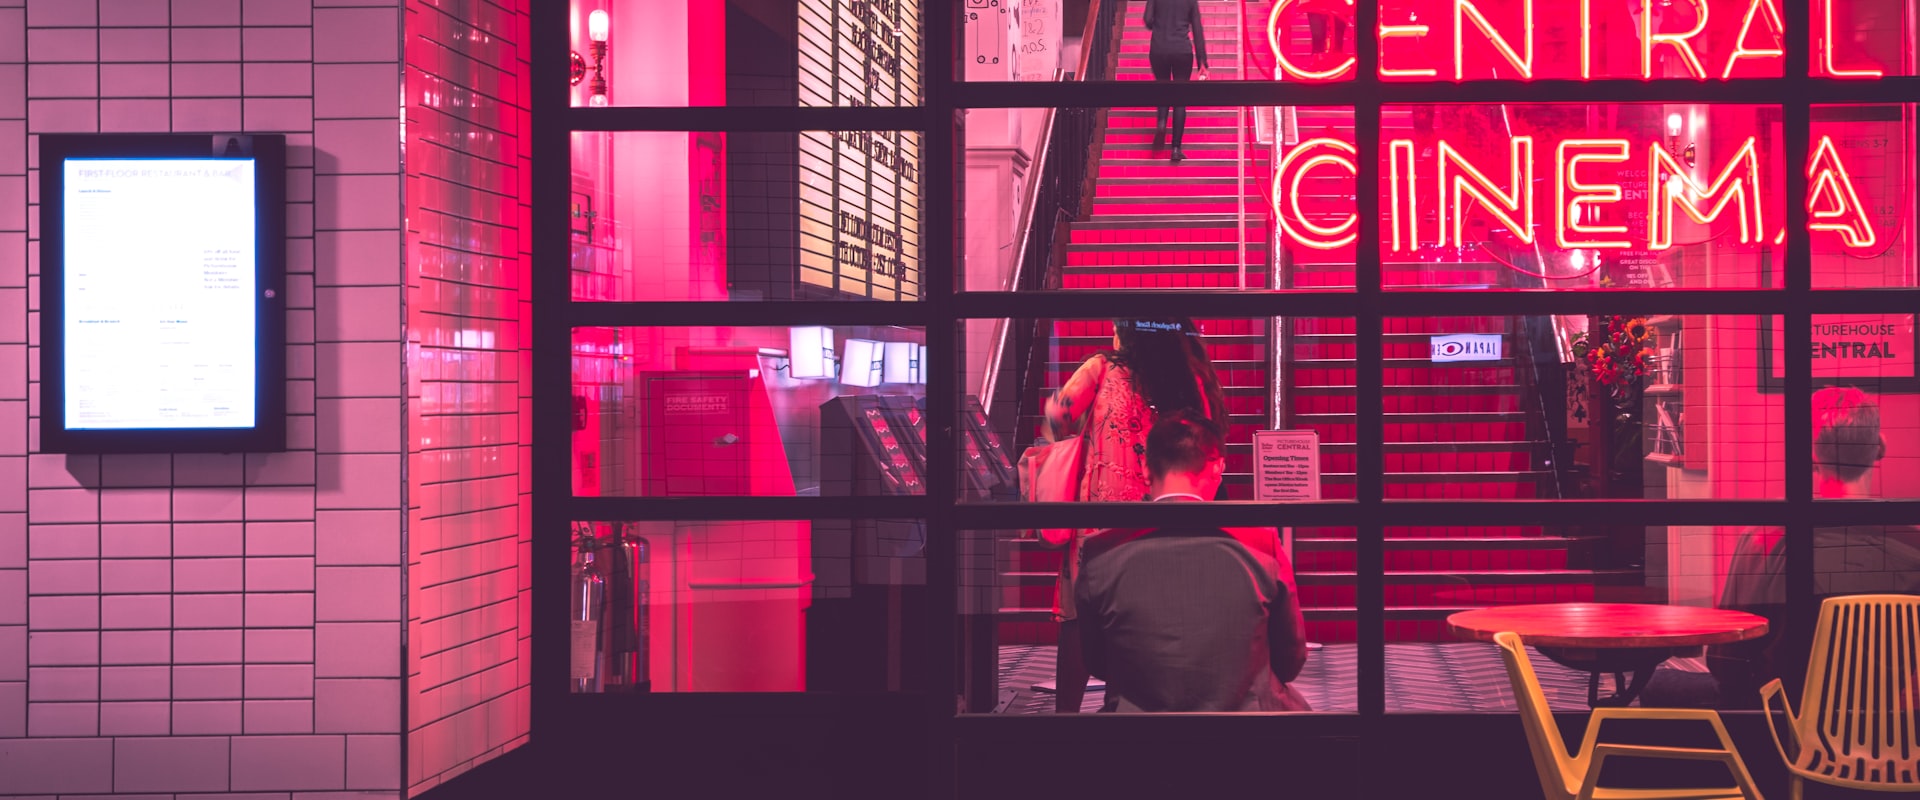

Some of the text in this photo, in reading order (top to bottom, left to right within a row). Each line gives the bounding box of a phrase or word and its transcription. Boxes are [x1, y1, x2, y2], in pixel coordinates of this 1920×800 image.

[1273, 135, 1875, 252] CINEMA
[1812, 324, 1895, 335] TUREHOUSE
[1811, 342, 1896, 358] ENTRAL
[691, 396, 727, 404] SAFETY
[667, 404, 727, 412] DOCUMENTS
